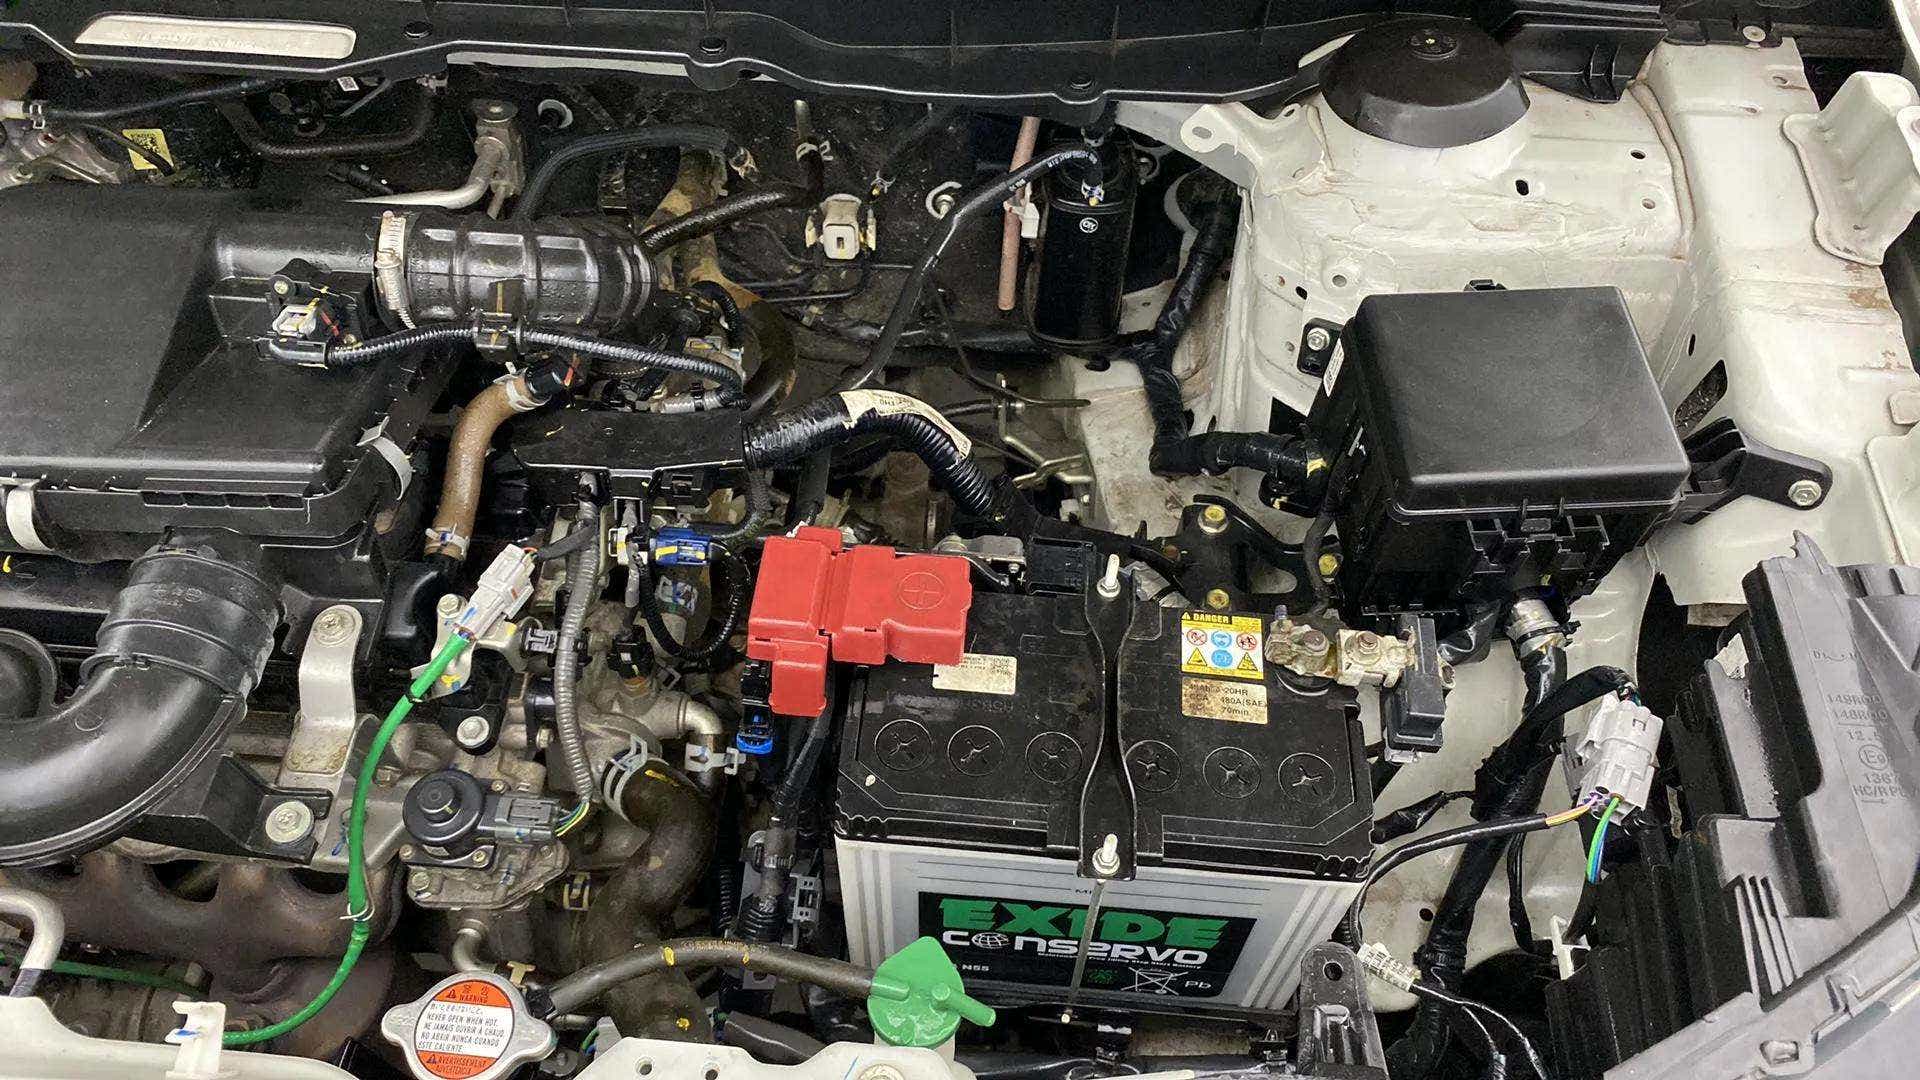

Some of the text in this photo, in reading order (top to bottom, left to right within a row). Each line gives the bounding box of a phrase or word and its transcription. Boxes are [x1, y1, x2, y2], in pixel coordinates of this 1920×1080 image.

[1193, 613, 1229, 623] DANGER
[938, 898, 1229, 949] EXIDE
[1185, 980, 1212, 989] Pb
[459, 994, 488, 1004] WARNING
[426, 1012, 446, 1021] NEVER
[447, 1014, 464, 1023] OPEN
[465, 1016, 483, 1025] WHEN
[420, 1031, 430, 1039] NO
